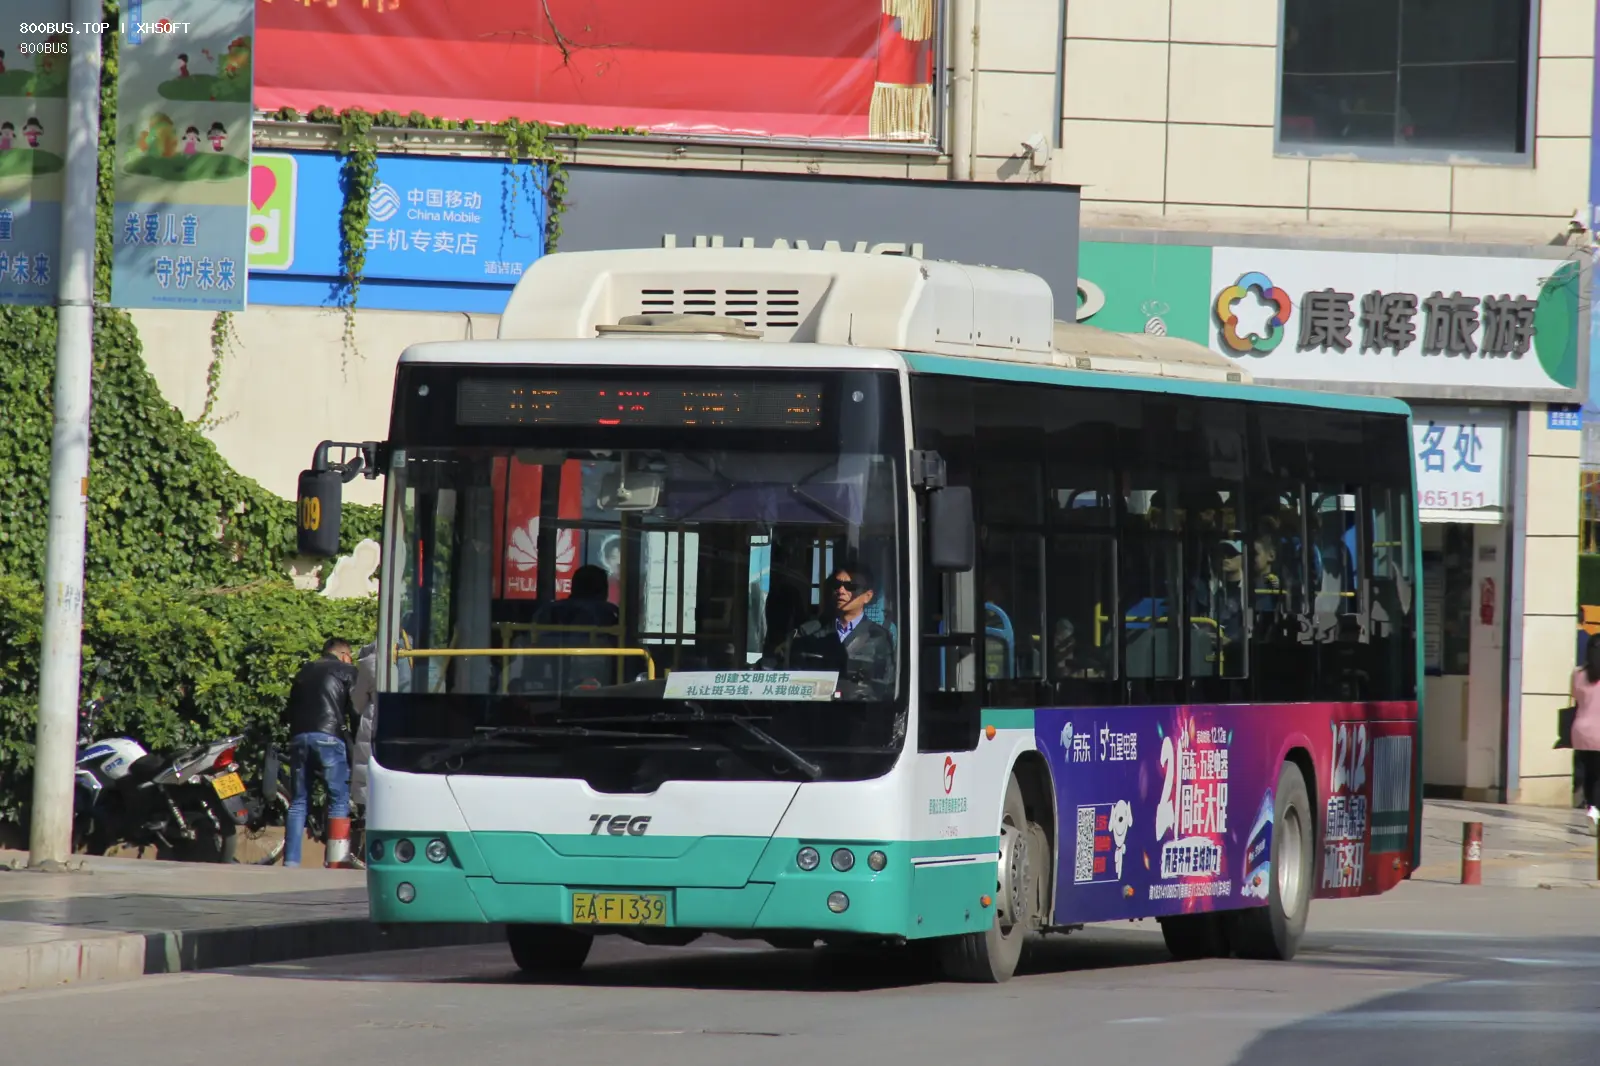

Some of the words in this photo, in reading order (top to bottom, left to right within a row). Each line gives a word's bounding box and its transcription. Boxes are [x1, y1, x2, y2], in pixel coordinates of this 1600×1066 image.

[406, 188, 482, 210] 中国移动
[124, 212, 198, 246] 关爱儿童
[406, 208, 441, 222] China
[443, 210, 481, 224] Mobile
[364, 228, 478, 255] 手机专卖店
[155, 256, 236, 290] 守护未来
[1297, 288, 1538, 358] 康辉旅游
[714, 672, 790, 684] 创建文明城市
[1073, 733, 1091, 762] 京东
[1109, 733, 1137, 761] 五星电器
[1181, 783, 1228, 834] 周年大促
[589, 814, 652, 836] TEG
